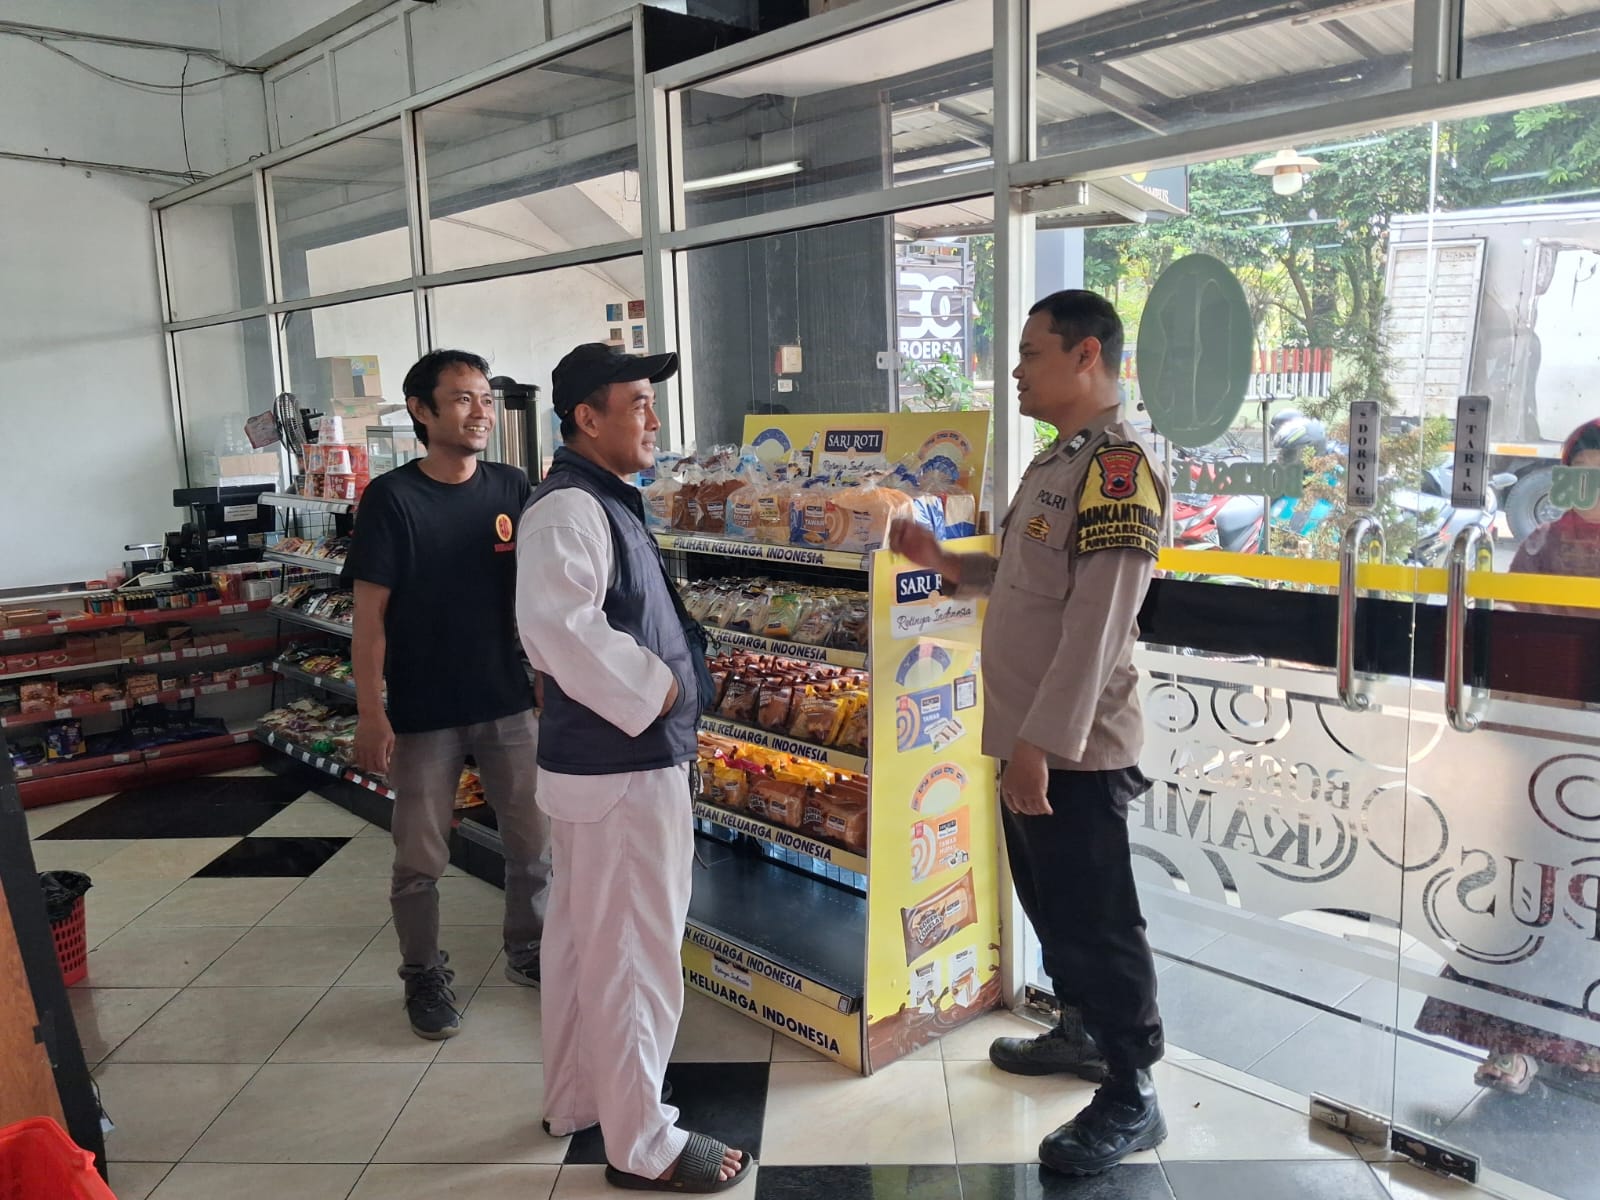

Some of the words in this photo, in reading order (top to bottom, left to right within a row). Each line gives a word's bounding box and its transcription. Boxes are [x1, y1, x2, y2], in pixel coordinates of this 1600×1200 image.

[899, 341, 963, 360] BOERSA
[828, 434, 851, 448] SARI
[853, 434, 880, 448] ROTI
[1355, 423, 1369, 496] DORONG
[1462, 424, 1477, 493] TARIK
[1036, 489, 1067, 511] POLRI
[674, 537, 710, 552] PILIHAN
[711, 541, 763, 558] KELUARGA
[766, 547, 825, 565] INDONESIA
[900, 573, 931, 596] SARI
[717, 633, 768, 651] KELUARGA
[770, 642, 828, 661] INDONESIA
[717, 724, 769, 747] KELUARGA
[771, 737, 829, 763] INDONESIA
[693, 804, 720, 822] LIHAN
[721, 813, 773, 840] KELUARGA
[775, 831, 832, 861] INDONESIA
[692, 930, 744, 964] KELUARGA
[746, 955, 803, 993] INDONESIA
[690, 970, 758, 1014] KELUARGA
[762, 1005, 841, 1055] INDONESIA
